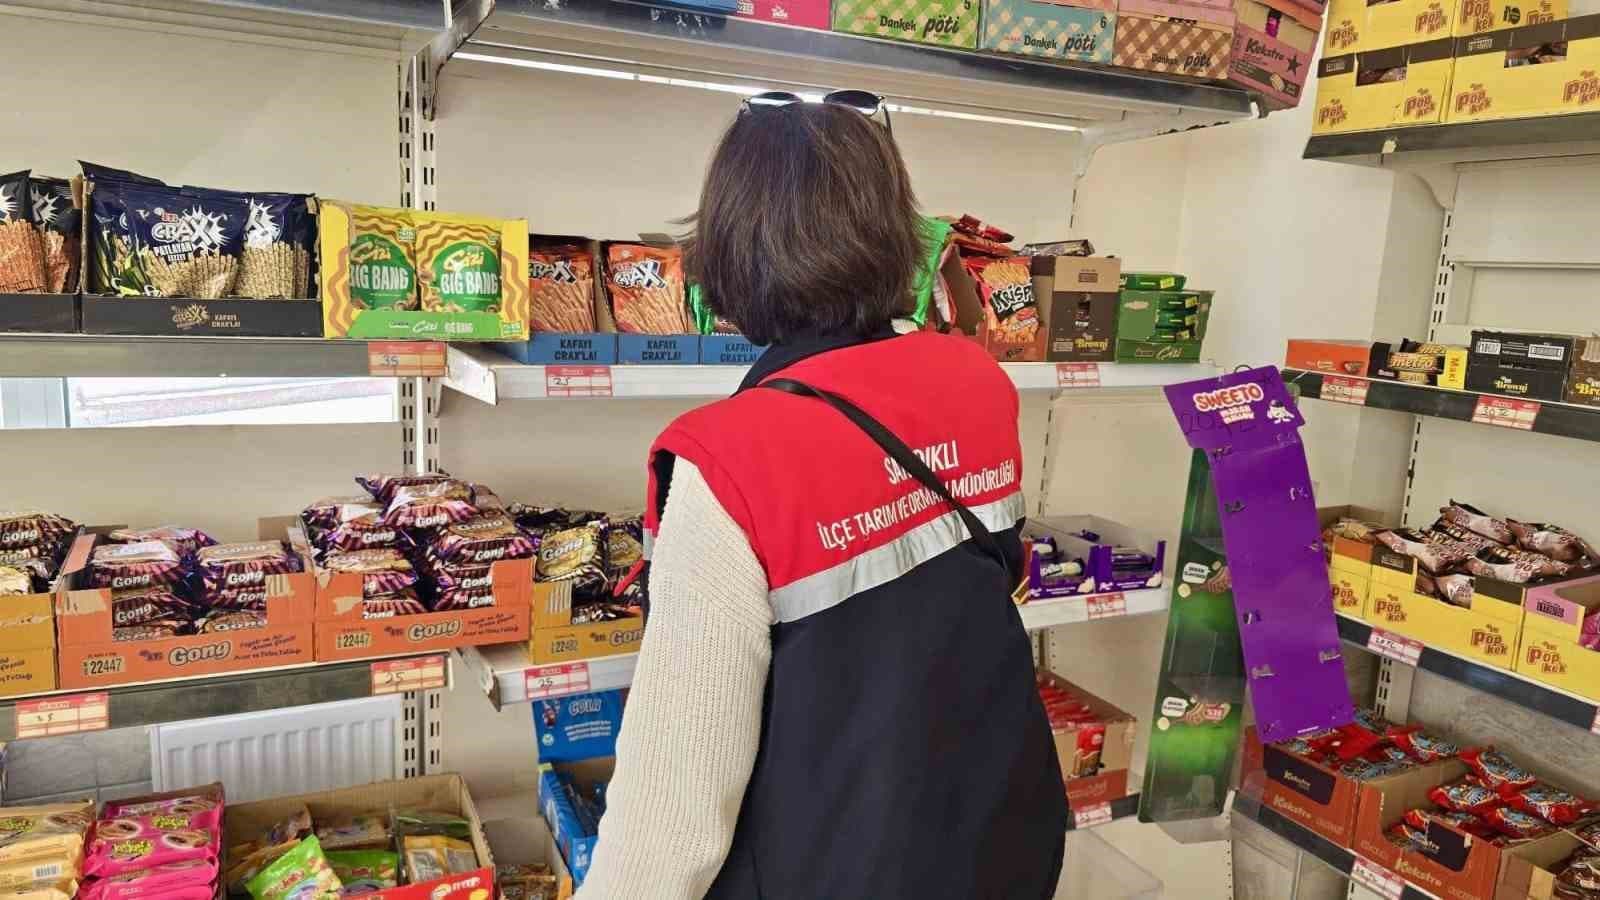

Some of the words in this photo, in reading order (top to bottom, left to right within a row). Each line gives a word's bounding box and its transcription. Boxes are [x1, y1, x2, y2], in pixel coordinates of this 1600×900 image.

[880, 15, 916, 32] Dankek
[922, 15, 960, 38] pöti
[1063, 34, 1096, 51] pöti
[1184, 52, 1210, 69] pöti
[372, 265, 409, 290] BANG
[613, 259, 667, 288] CRAX
[441, 271, 464, 295] BIG
[465, 271, 499, 295] BANG
[560, 340, 592, 350] KAFAYI
[647, 340, 677, 350] KAFAYI
[1193, 384, 1263, 411] SWEETO
[884, 440, 959, 484] SAIKLI
[817, 518, 856, 550] İLÇE
[854, 505, 898, 537] TARIM
[951, 458, 1015, 498] MÜDÜRLÜĞÜ
[415, 513, 448, 527] Gong
[1, 529, 38, 543] Gong
[363, 531, 396, 543] Gong
[475, 547, 504, 561] Gong
[543, 538, 583, 561] Gong
[112, 574, 150, 588] Gong
[227, 571, 264, 585] Gong
[115, 603, 152, 622] Gong
[408, 620, 460, 642] Gong
[1471, 629, 1502, 646] Pop
[1486, 643, 1508, 655] kek
[1527, 645, 1560, 665] Pop
[91, 659, 122, 675] 22447
[169, 641, 231, 666] Gong
[1542, 661, 1566, 673] kek
